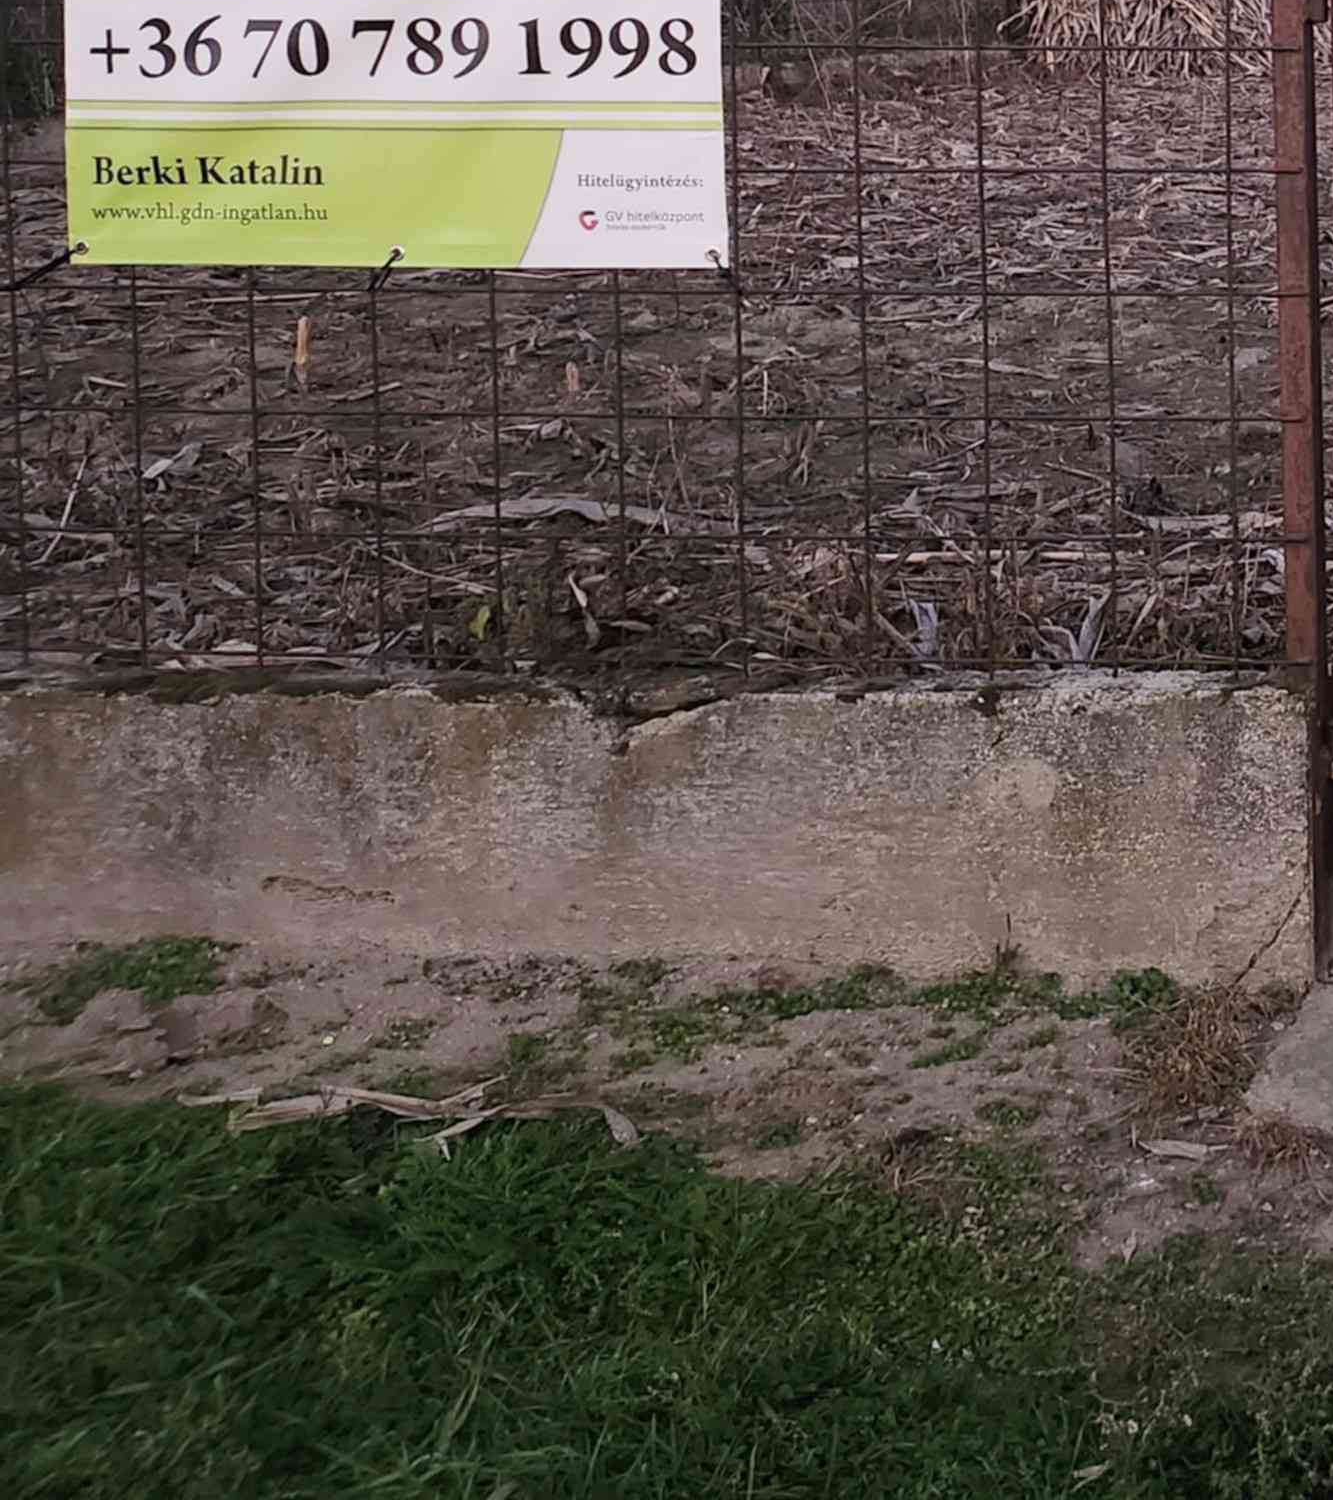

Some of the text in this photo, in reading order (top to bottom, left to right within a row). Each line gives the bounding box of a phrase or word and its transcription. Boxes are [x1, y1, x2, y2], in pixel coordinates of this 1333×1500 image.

[90, 15, 697, 78] +36 70 789 1998
[92, 155, 324, 185] Berki Katalin
[577, 174, 704, 192] Hitelügyintézés:
[92, 201, 328, 225] www.vhl.gdn-ingatlan.hu
